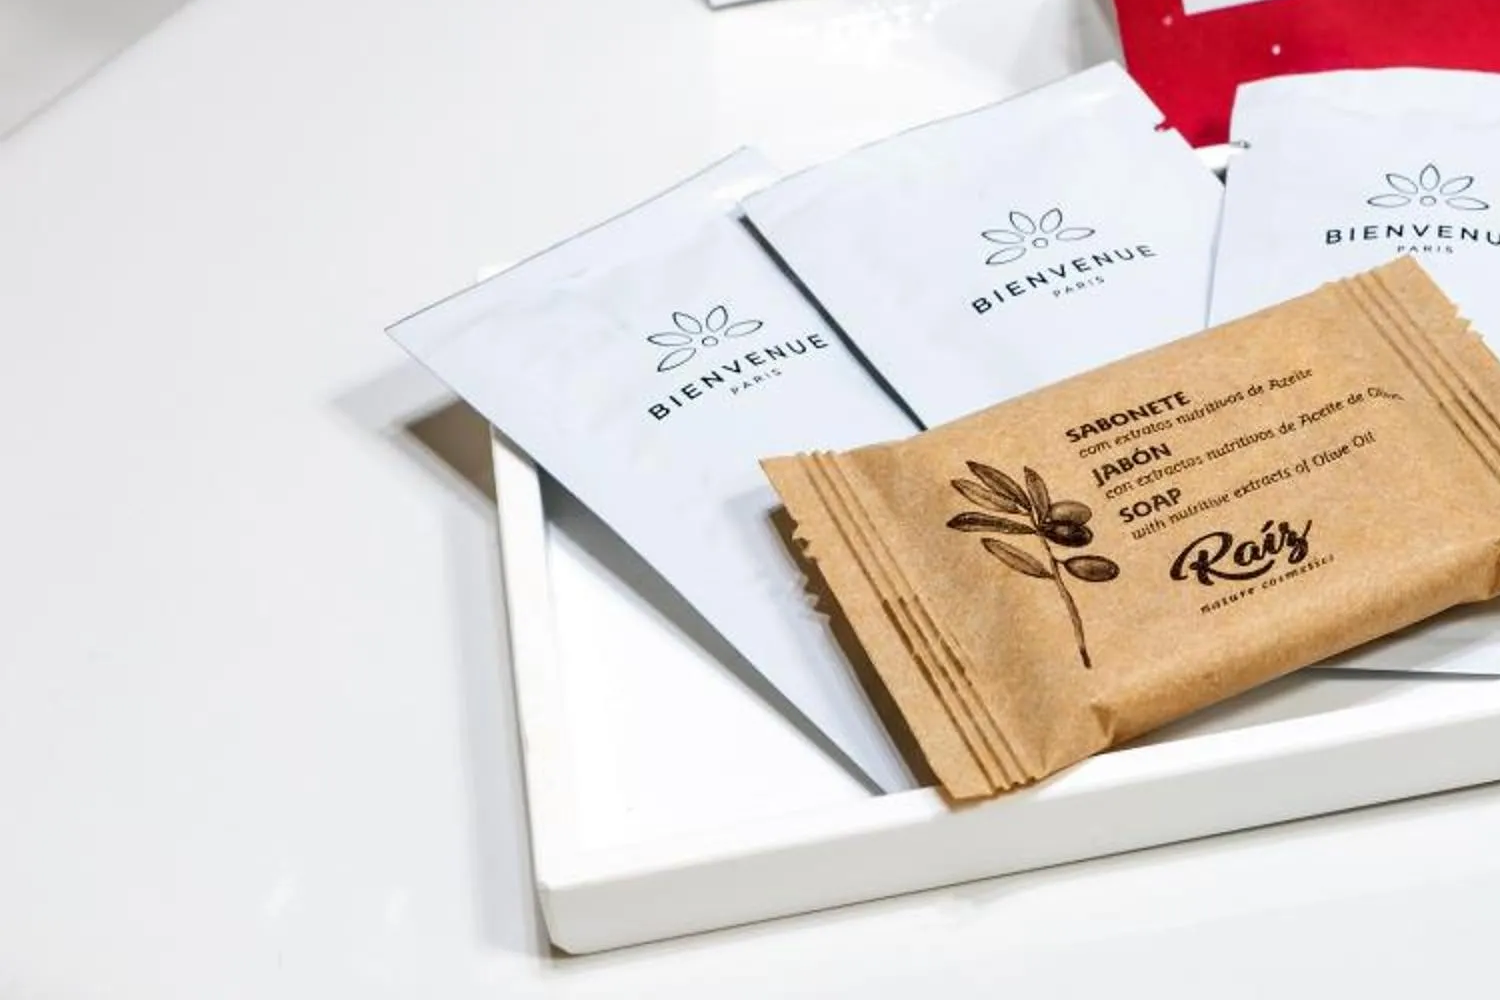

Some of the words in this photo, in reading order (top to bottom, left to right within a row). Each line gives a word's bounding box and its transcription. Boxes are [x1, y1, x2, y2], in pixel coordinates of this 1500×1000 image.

[971, 243, 1158, 315] BIENVENUE
[1396, 245, 1454, 254] PARIS
[1052, 275, 1105, 298] PARIS
[648, 332, 830, 422] BIENVENUE
[729, 367, 783, 396] PARIS
[1065, 391, 1192, 443] SABONETE
[1079, 439, 1112, 459] com
[1115, 419, 1173, 446] extratos
[1176, 391, 1244, 425] nutritivos
[1247, 384, 1265, 398] de
[1268, 368, 1313, 390] Azeite
[1092, 443, 1172, 488] JABÓN
[1105, 481, 1135, 499] con
[1137, 455, 1203, 486] extractos
[1206, 428, 1275, 462] nutritivos
[1279, 420, 1297, 435] de
[1298, 400, 1345, 426] Aceite
[1347, 392, 1365, 405] de
[1120, 487, 1182, 523] SOAP
[1131, 517, 1167, 540] with
[1169, 493, 1230, 524] nutritive
[1233, 467, 1292, 498] extracts
[1295, 459, 1311, 474] of
[1312, 443, 1350, 467] Olive
[1352, 430, 1376, 448] Oil
[1169, 519, 1312, 586] Raíz
[1199, 587, 1255, 614] nature
[1261, 554, 1334, 589] cosmetics
